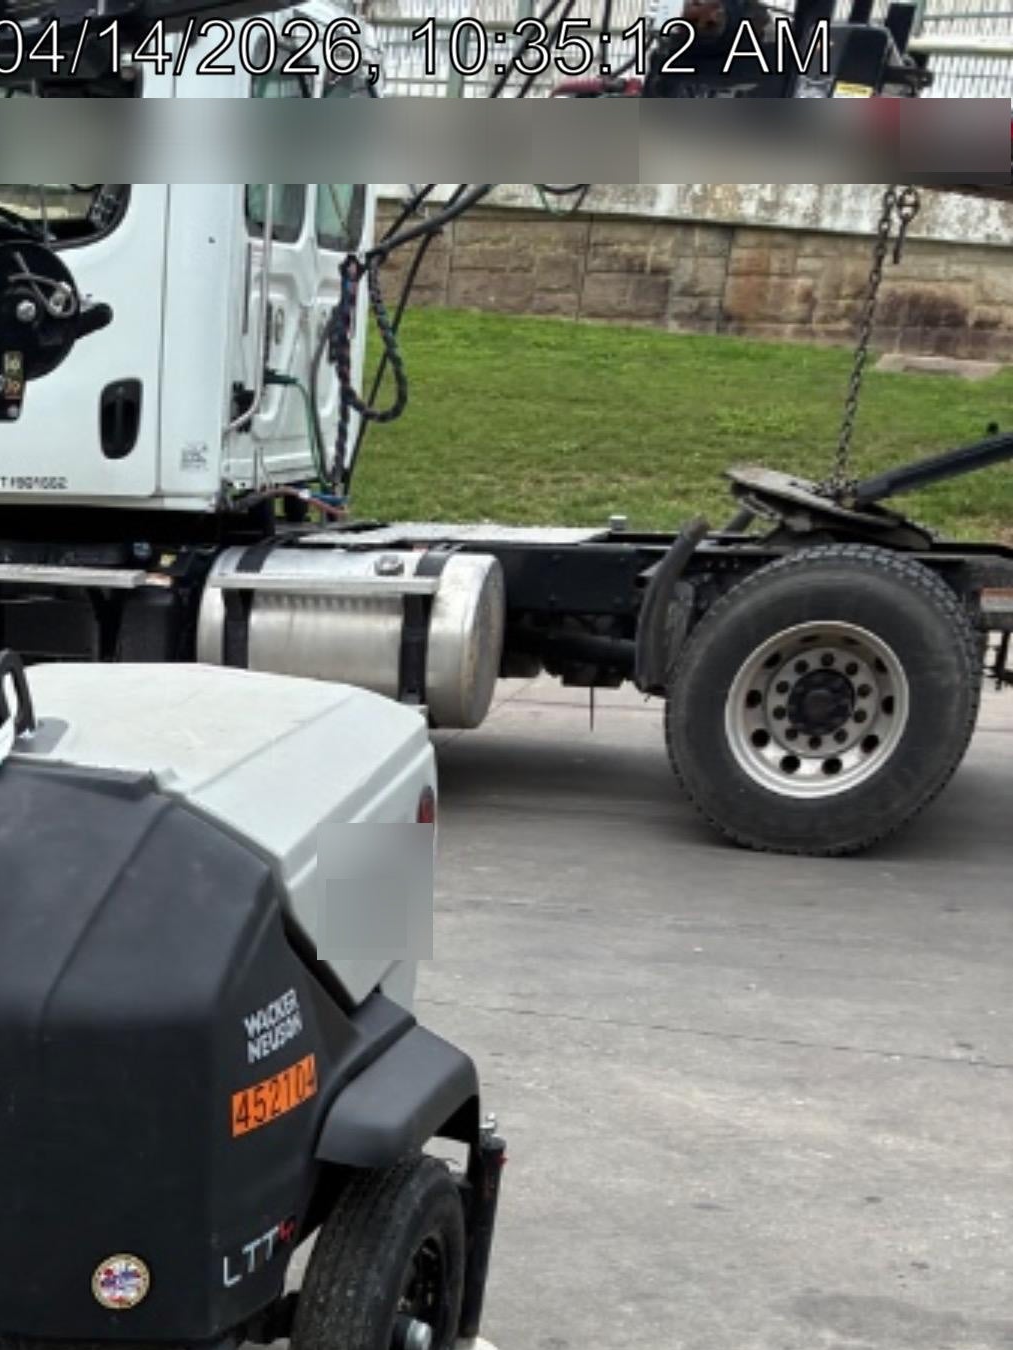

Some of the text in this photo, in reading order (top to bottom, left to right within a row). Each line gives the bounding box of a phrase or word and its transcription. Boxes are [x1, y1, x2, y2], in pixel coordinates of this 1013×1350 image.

[244, 988, 299, 1039] WACKER
[247, 1010, 303, 1064] NEUSON
[235, 1059, 316, 1130] 452104
